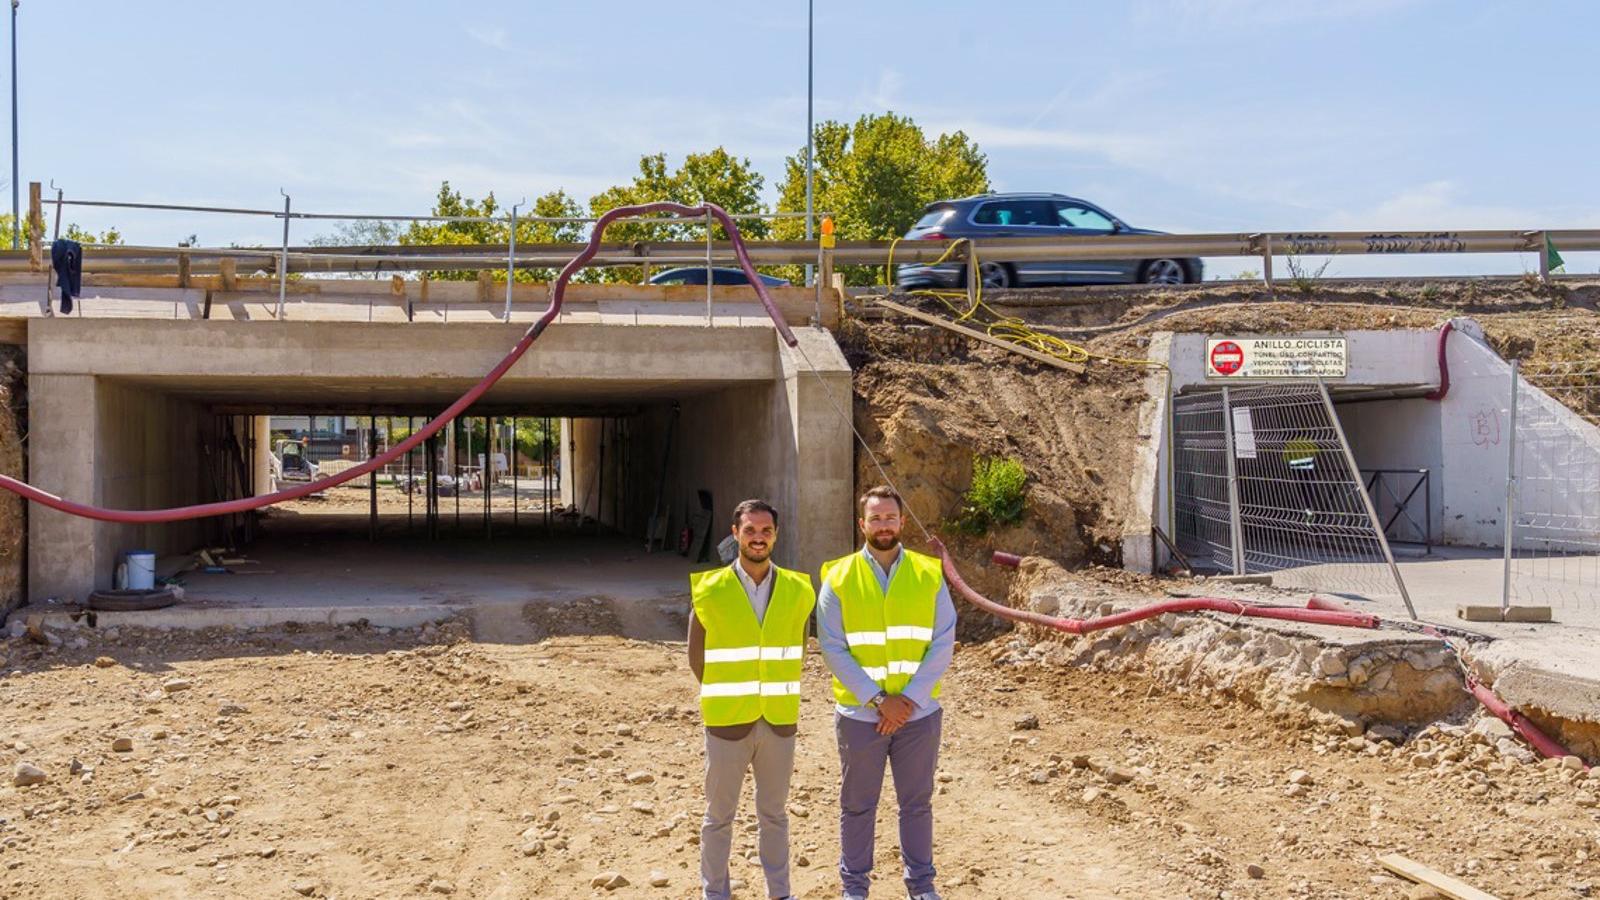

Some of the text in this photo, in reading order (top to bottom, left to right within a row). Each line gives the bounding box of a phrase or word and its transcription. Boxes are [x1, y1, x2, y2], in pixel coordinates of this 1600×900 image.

[1254, 341, 1343, 349] ANILLO CICLISTA
[1297, 351, 1342, 359] COMPARTIDO
